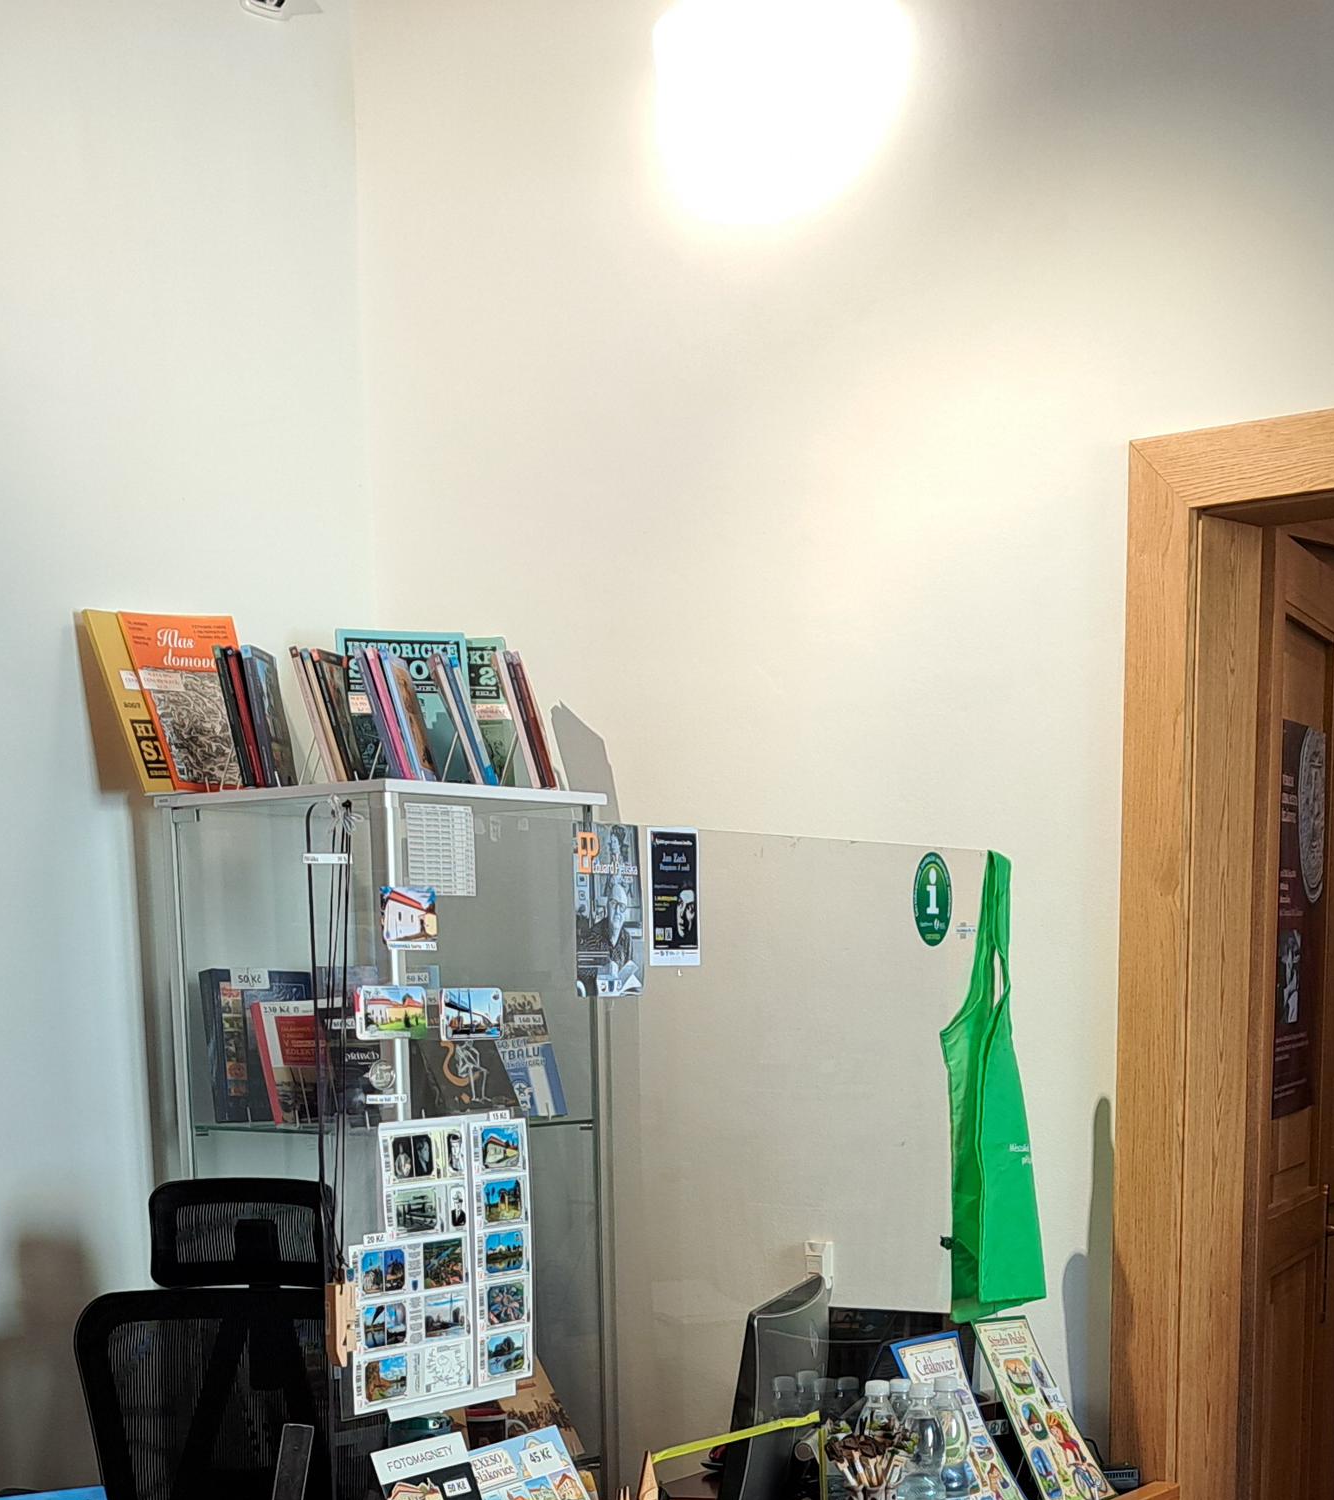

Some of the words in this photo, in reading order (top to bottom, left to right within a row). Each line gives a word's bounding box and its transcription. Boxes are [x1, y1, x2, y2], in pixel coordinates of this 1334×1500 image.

[387, 1445, 454, 1472] FOTOMAGNETY
[529, 1450, 539, 1463] 45
[540, 1447, 553, 1460] Kč
